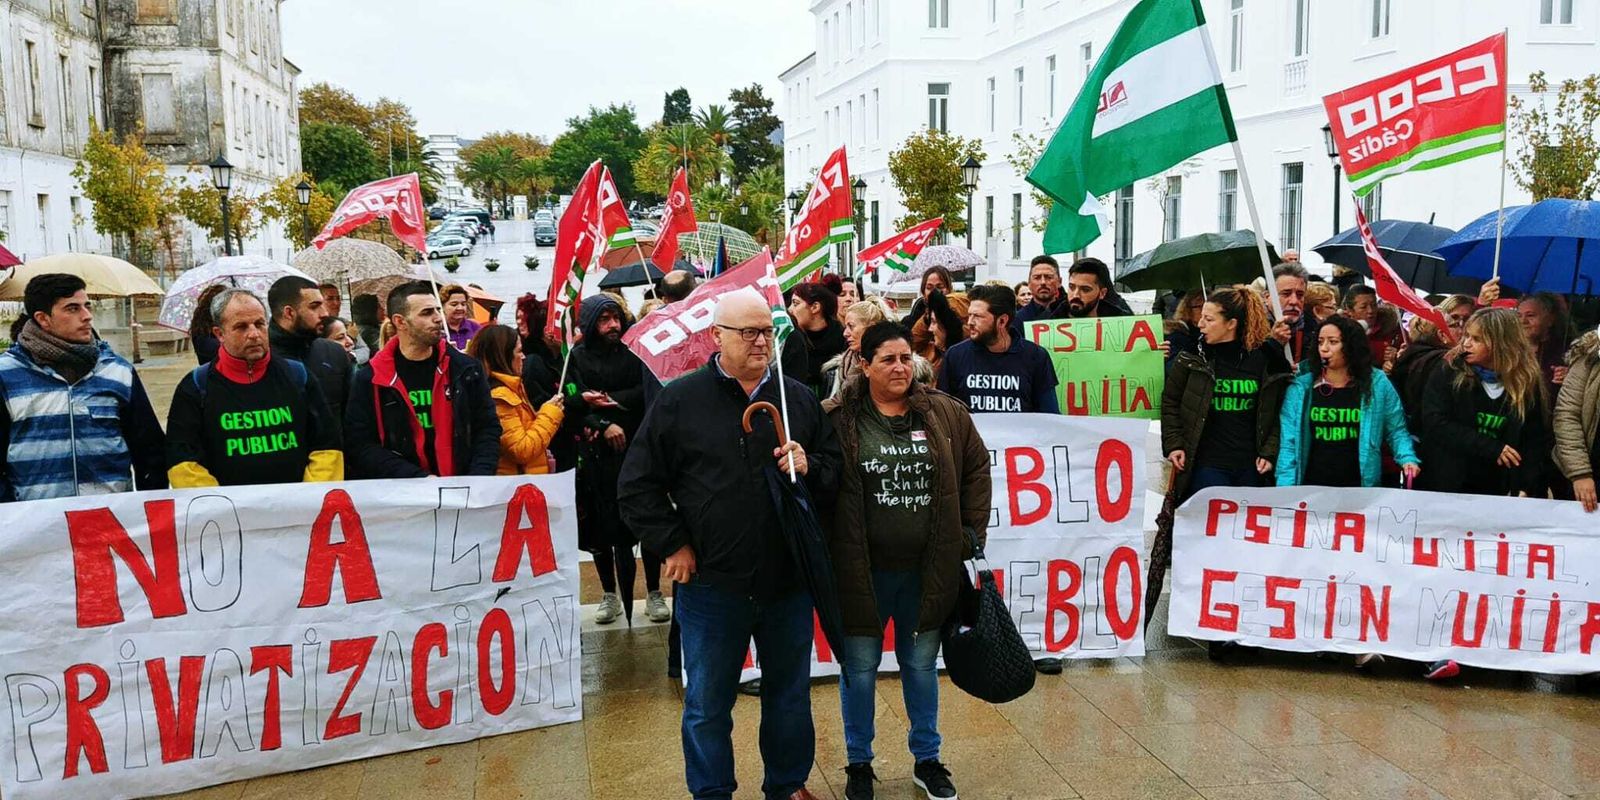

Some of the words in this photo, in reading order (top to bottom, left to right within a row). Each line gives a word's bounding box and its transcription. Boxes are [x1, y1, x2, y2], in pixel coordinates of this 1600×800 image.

[1031, 318, 1159, 353] PISCINA
[966, 374, 1020, 391] GESTION
[1213, 378, 1259, 395] ESTION
[970, 395, 1021, 412] PUBLICA
[1211, 396, 1255, 412] UBLIC
[1310, 407, 1361, 424] GESTIO
[220, 406, 293, 431] GESTION
[226, 431, 298, 457] PUBLICA
[861, 458, 890, 474] the
[1205, 499, 1366, 554] PISCINA
[65, 494, 244, 628] NO
[297, 488, 383, 608] A
[430, 483, 558, 592] LA
[1197, 568, 1392, 643] GESTIÓN
[1415, 587, 1600, 655] MUNICIPA
[4, 586, 576, 783] PRIVATIZACIÓN
